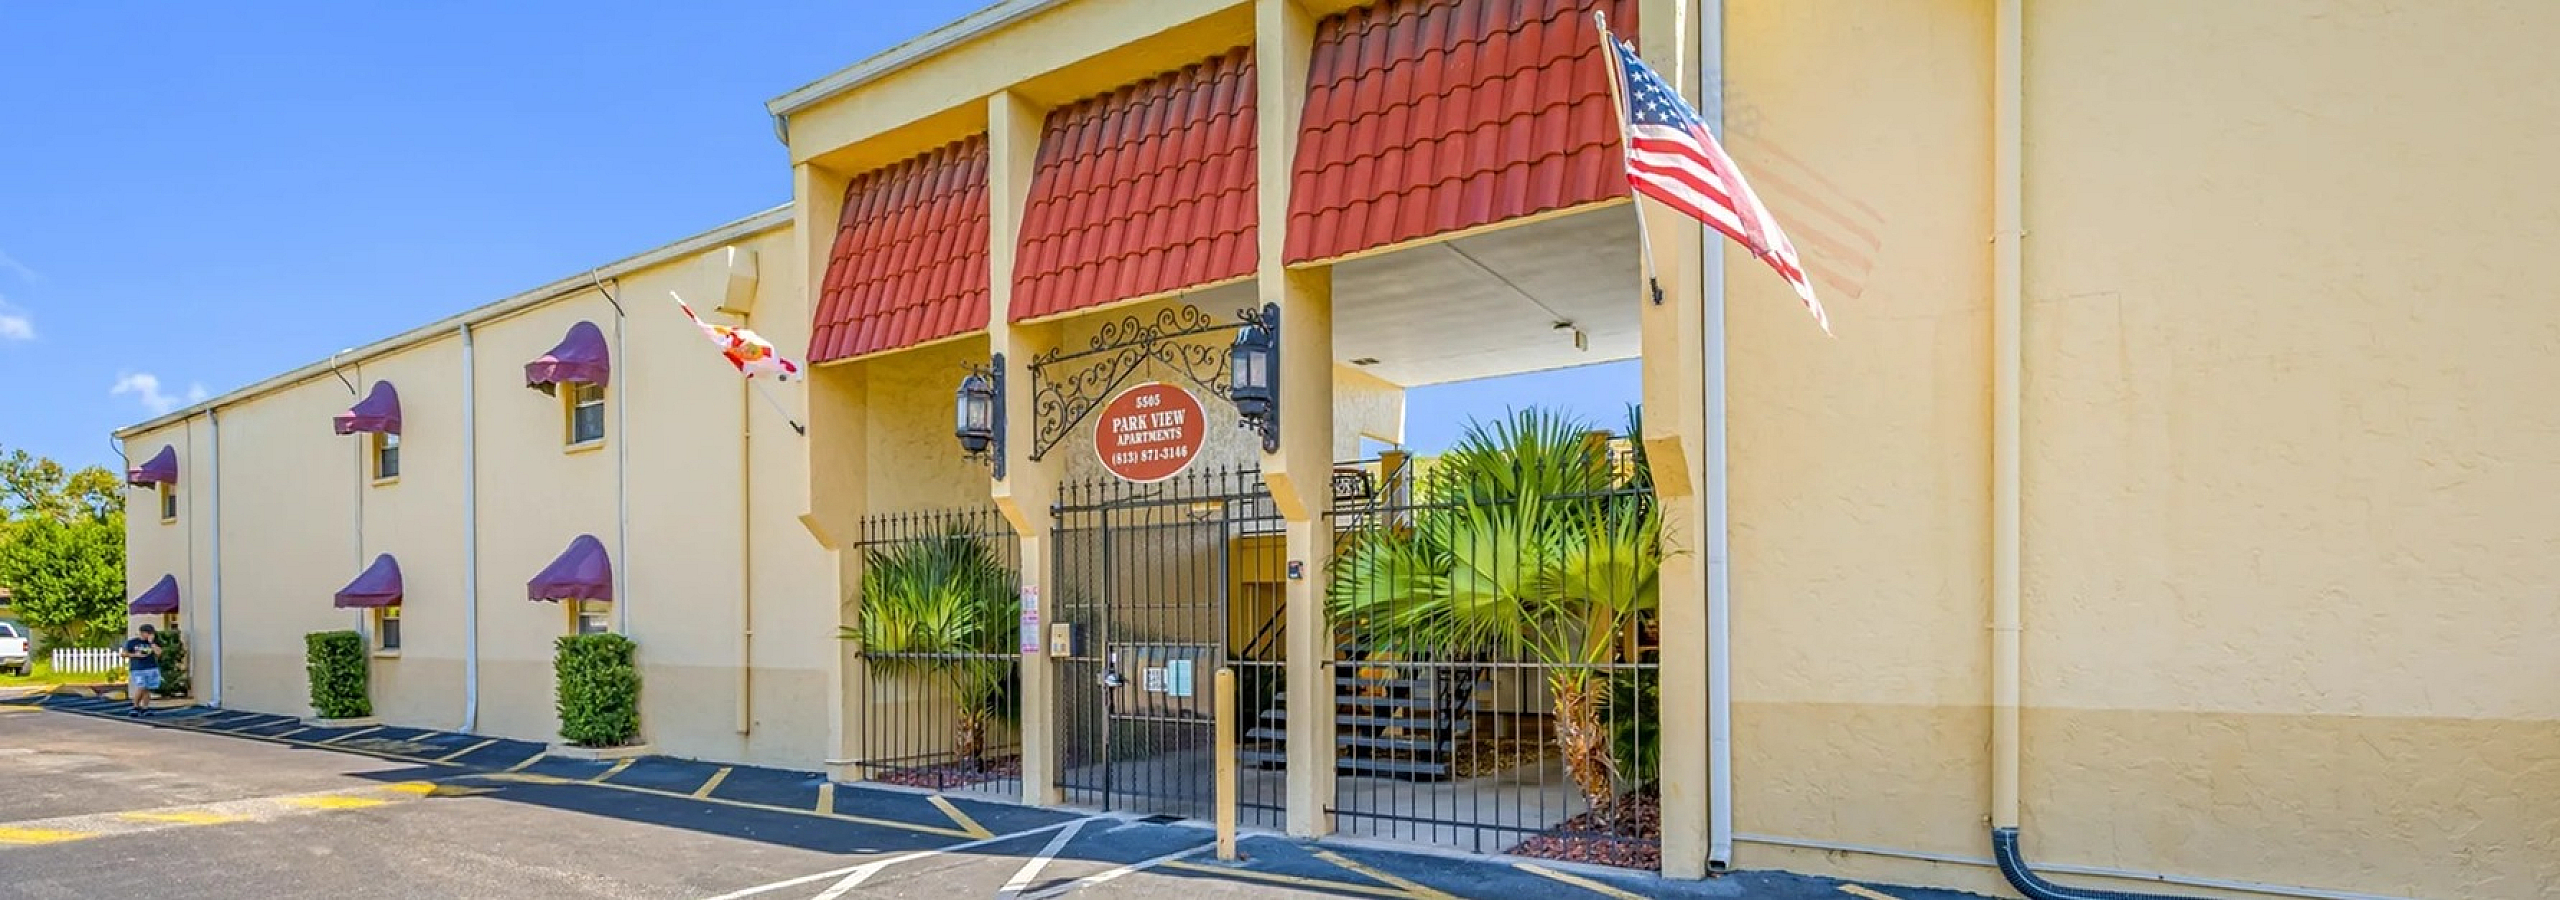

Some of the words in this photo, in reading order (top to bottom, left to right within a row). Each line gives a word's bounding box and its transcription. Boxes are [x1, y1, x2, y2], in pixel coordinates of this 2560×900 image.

[1135, 394, 1161, 409] 5505
[1112, 413, 1147, 434] PARK
[1151, 408, 1186, 428] VIEW
[1117, 426, 1182, 446] APARTMENTS
[1111, 450, 1138, 466] (813)
[1141, 445, 1188, 462] 871-3146
